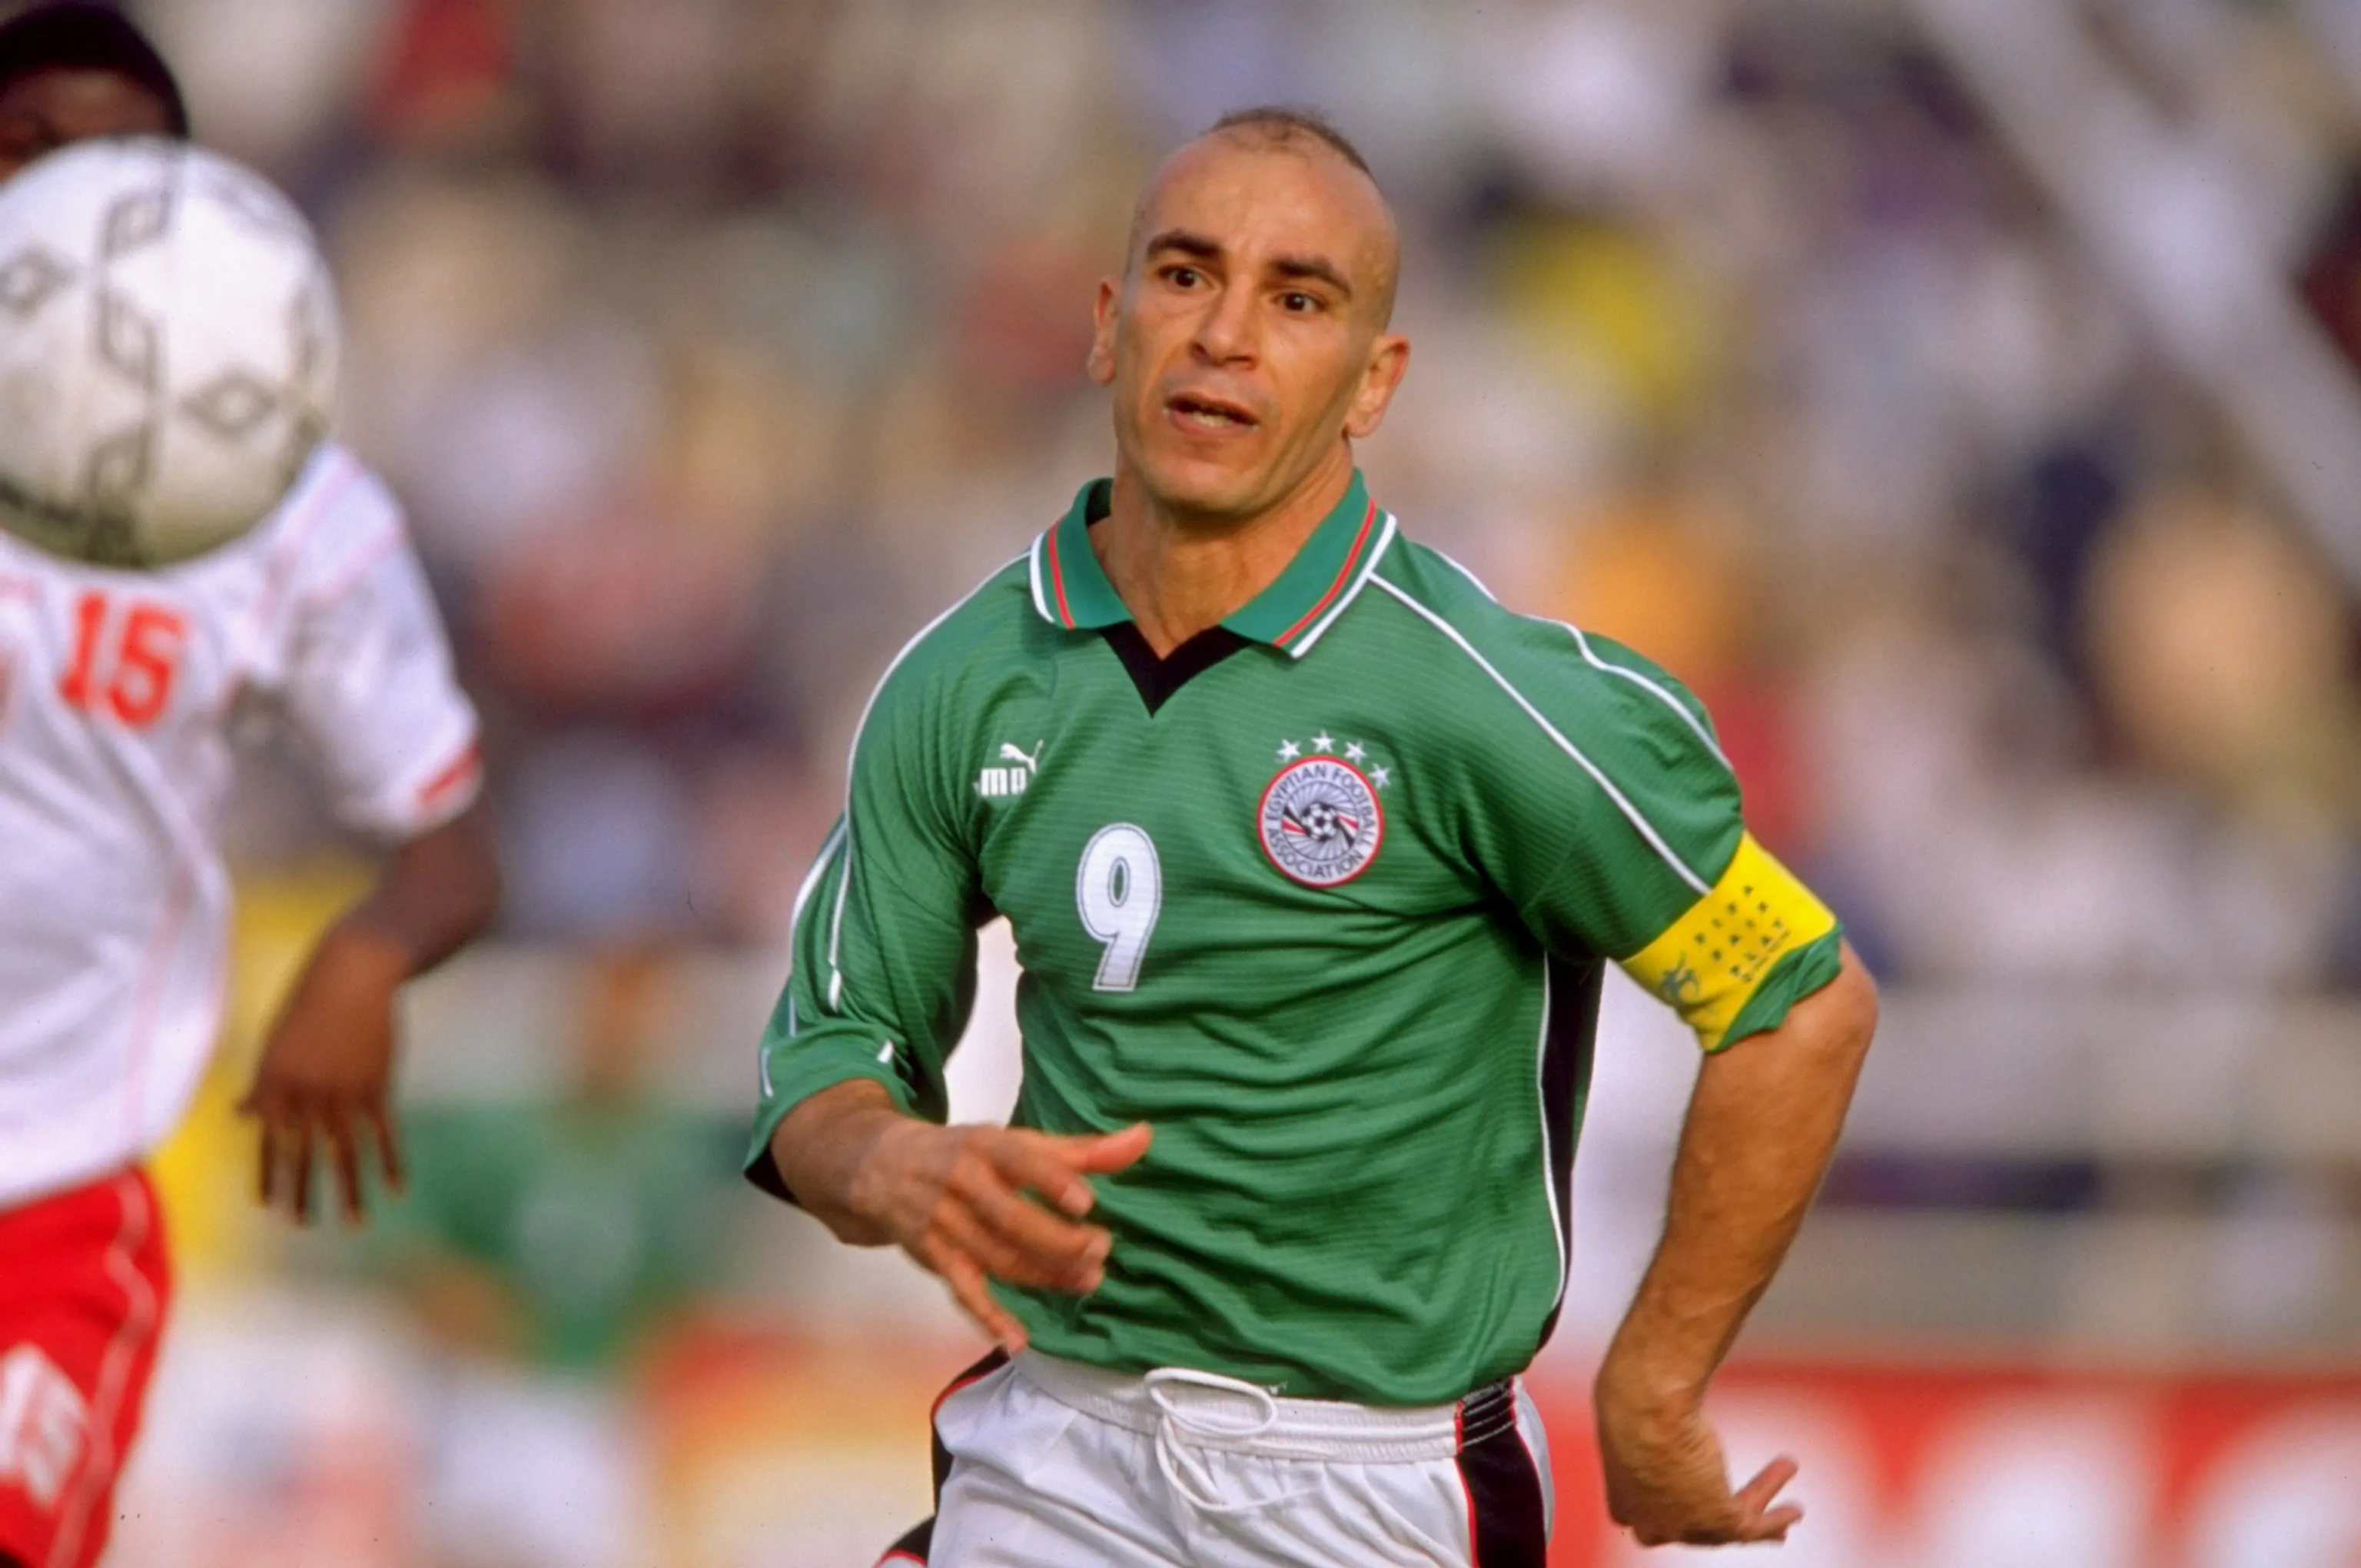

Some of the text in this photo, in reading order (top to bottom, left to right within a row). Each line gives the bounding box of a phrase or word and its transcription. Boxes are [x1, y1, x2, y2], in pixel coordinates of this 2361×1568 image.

[58, 590, 184, 730] 15
[1267, 764, 1375, 845] EGYPTIAN FOOTBALL
[1267, 828, 1365, 878] ASSOCIATION
[1076, 822, 1161, 991] 9
